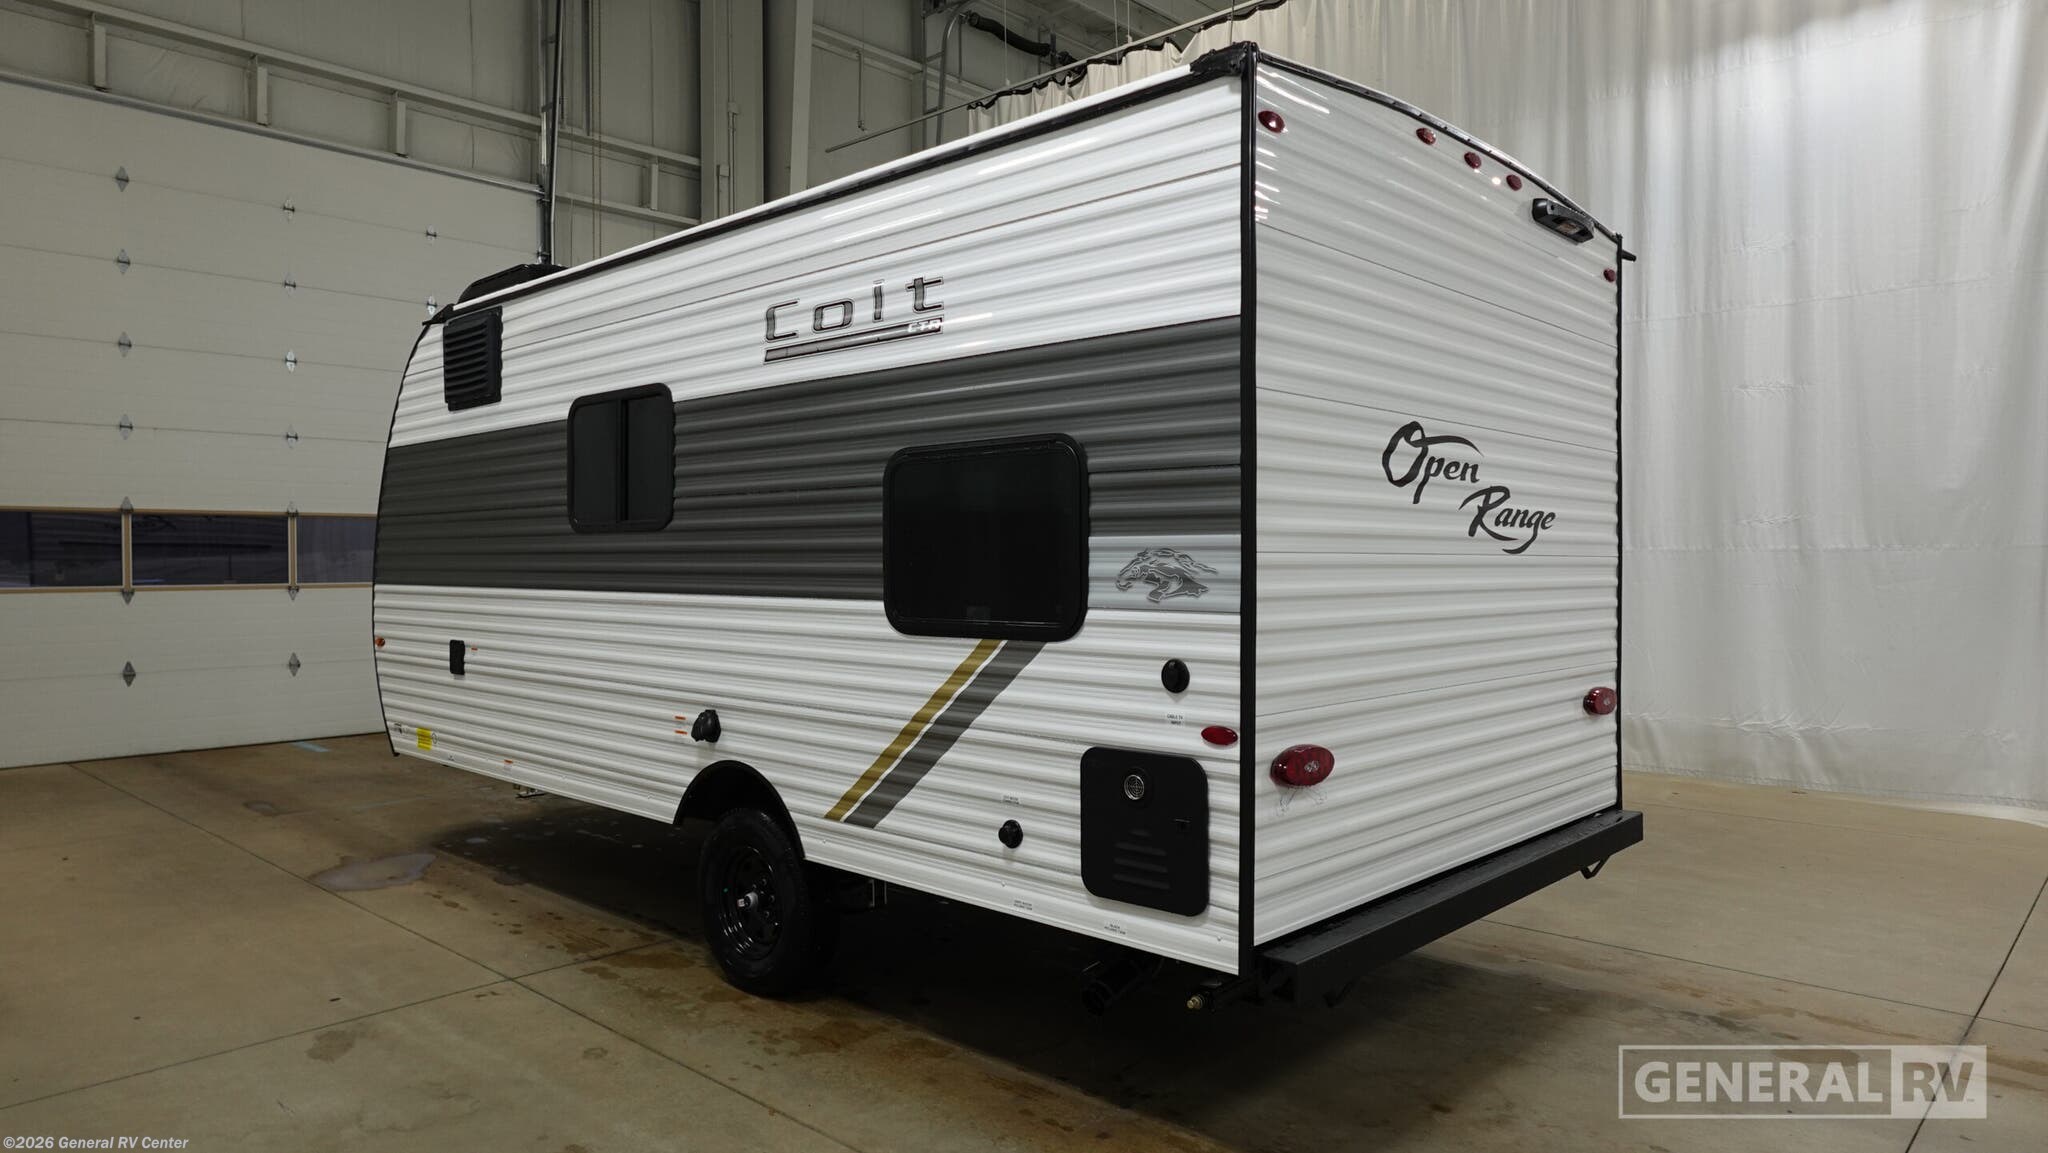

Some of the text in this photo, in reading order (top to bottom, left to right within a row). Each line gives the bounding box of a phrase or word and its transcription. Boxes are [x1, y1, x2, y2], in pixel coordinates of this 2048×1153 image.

[765, 275, 944, 343] Colt
[1381, 420, 1485, 505] Open
[1457, 485, 1557, 555] Range
